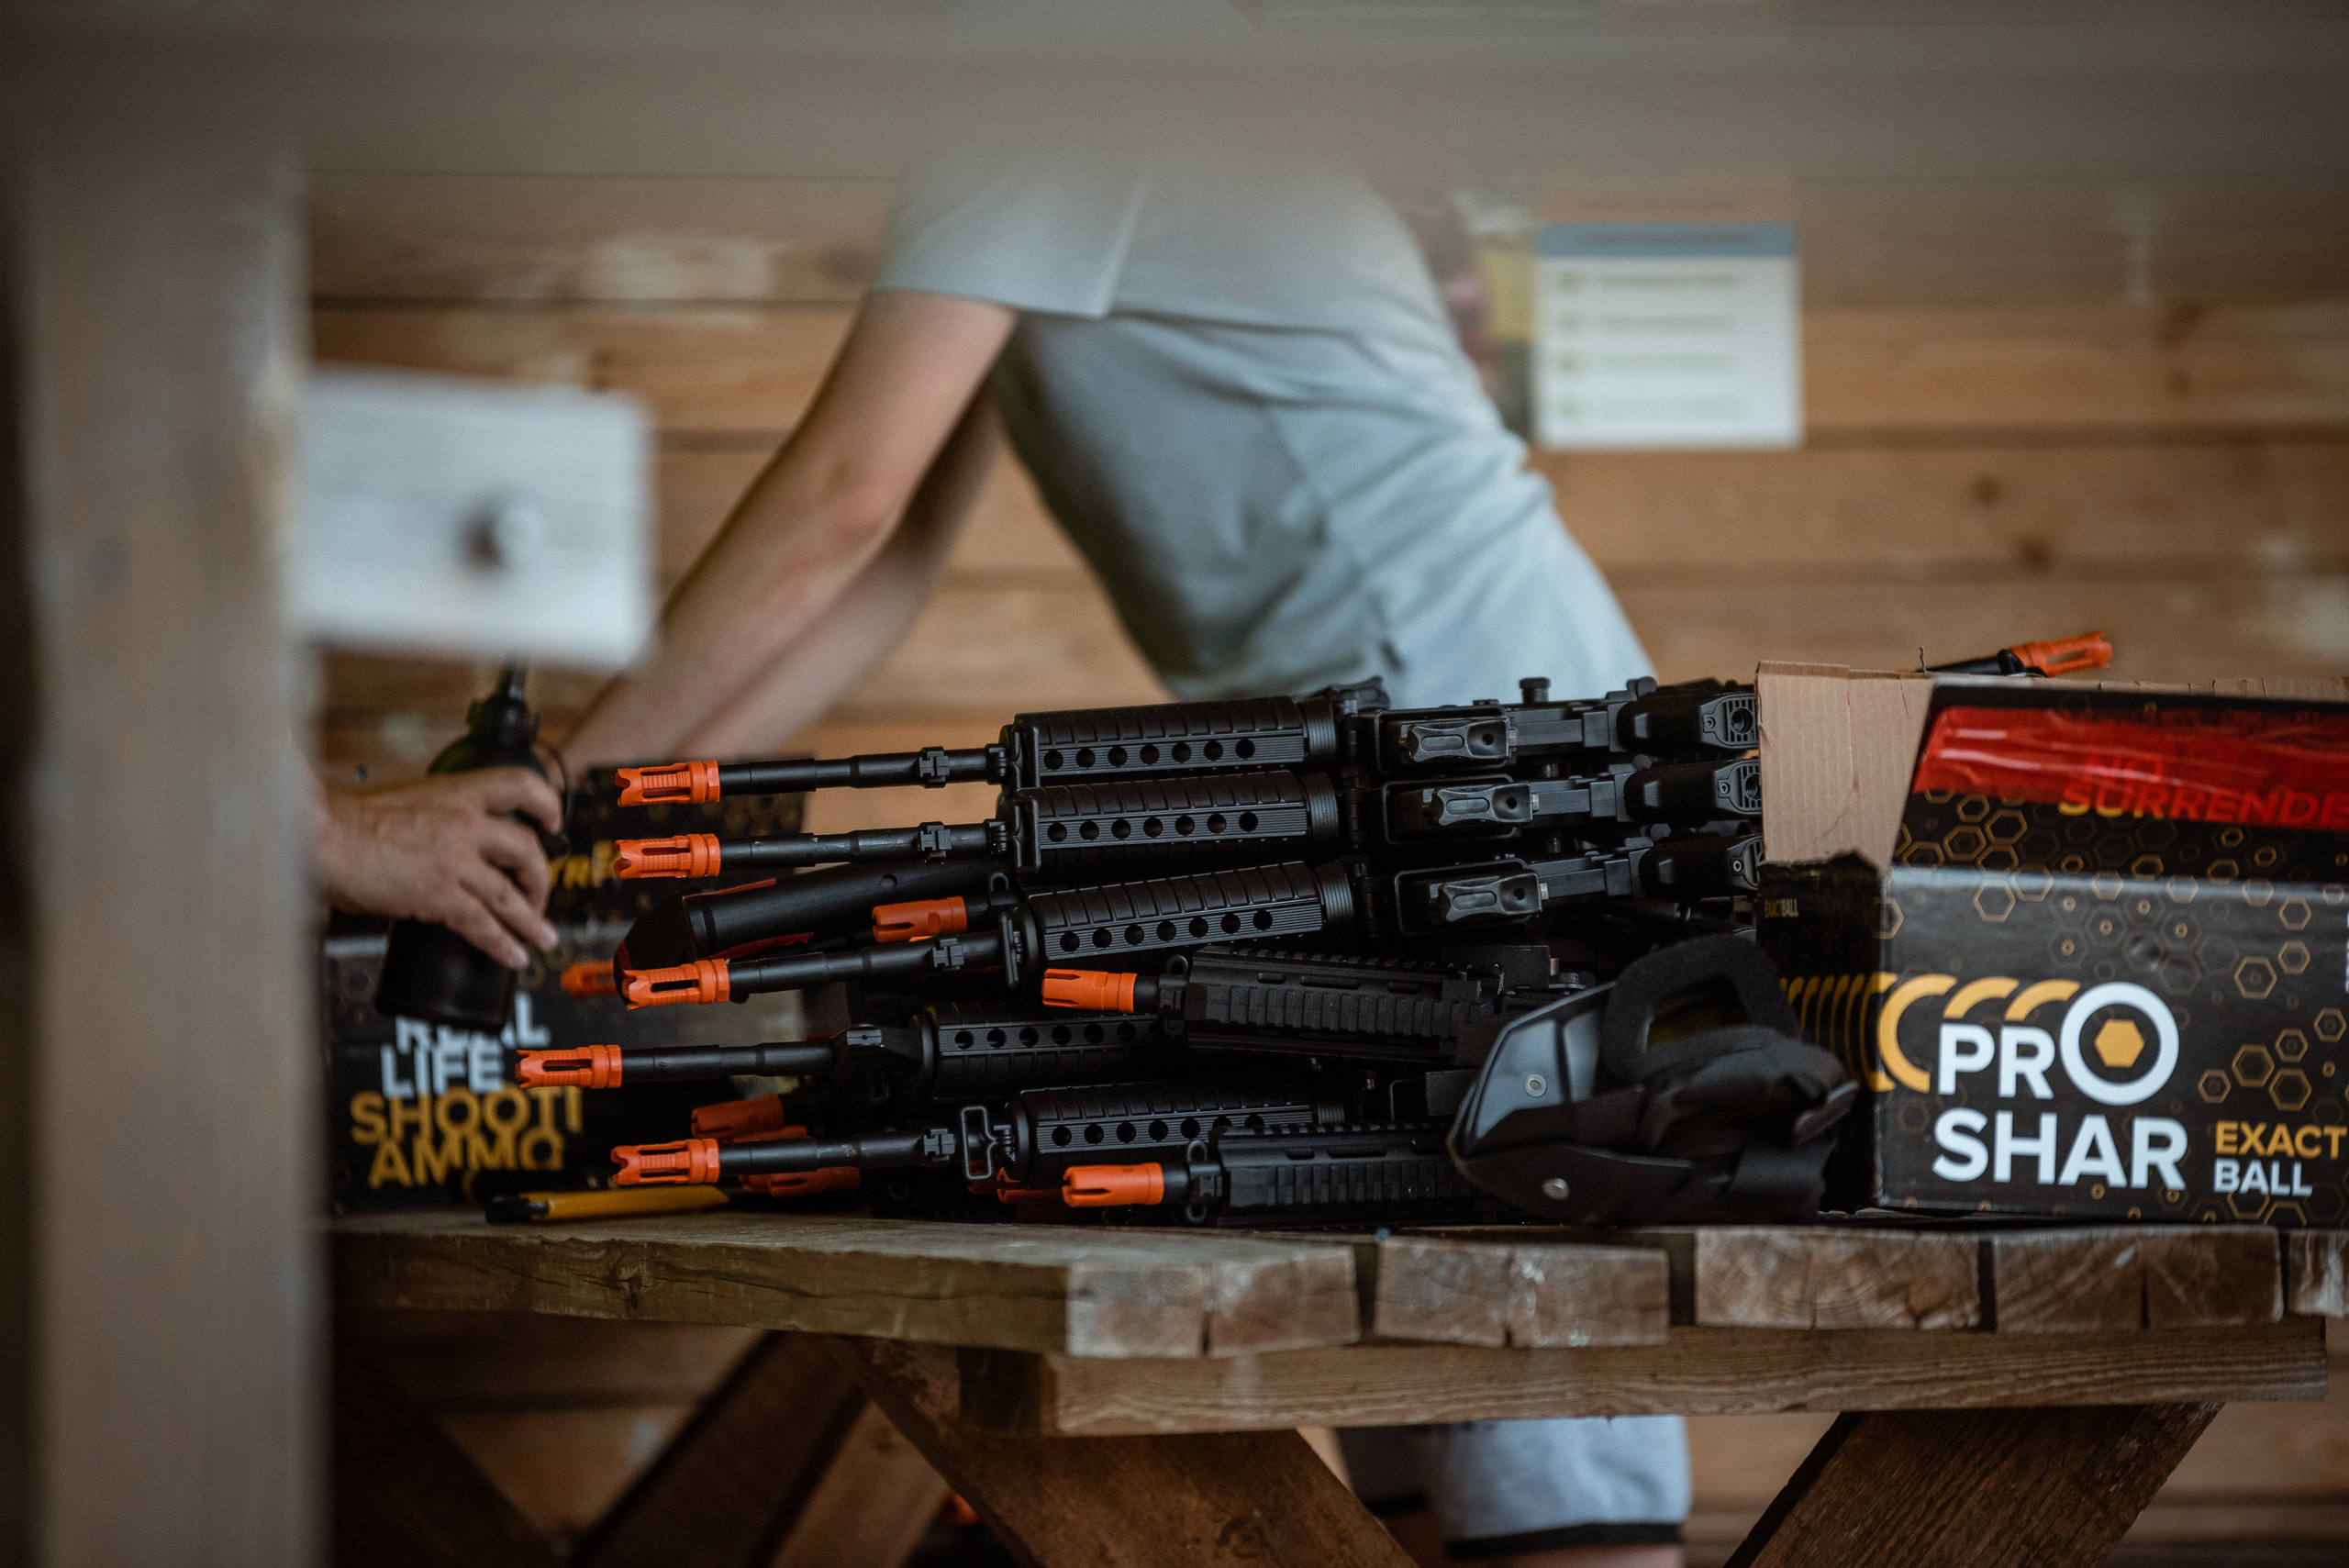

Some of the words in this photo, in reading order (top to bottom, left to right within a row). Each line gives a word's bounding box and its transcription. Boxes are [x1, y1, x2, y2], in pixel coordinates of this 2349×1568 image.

[380, 1042, 506, 1099] LIFE
[1938, 982, 2180, 1106] PRO
[367, 1128, 565, 1190] AMMO
[1932, 1107, 2188, 1191] SHAR
[2214, 1120, 2348, 1160] EXACT
[2213, 1157, 2313, 1197] BALL
